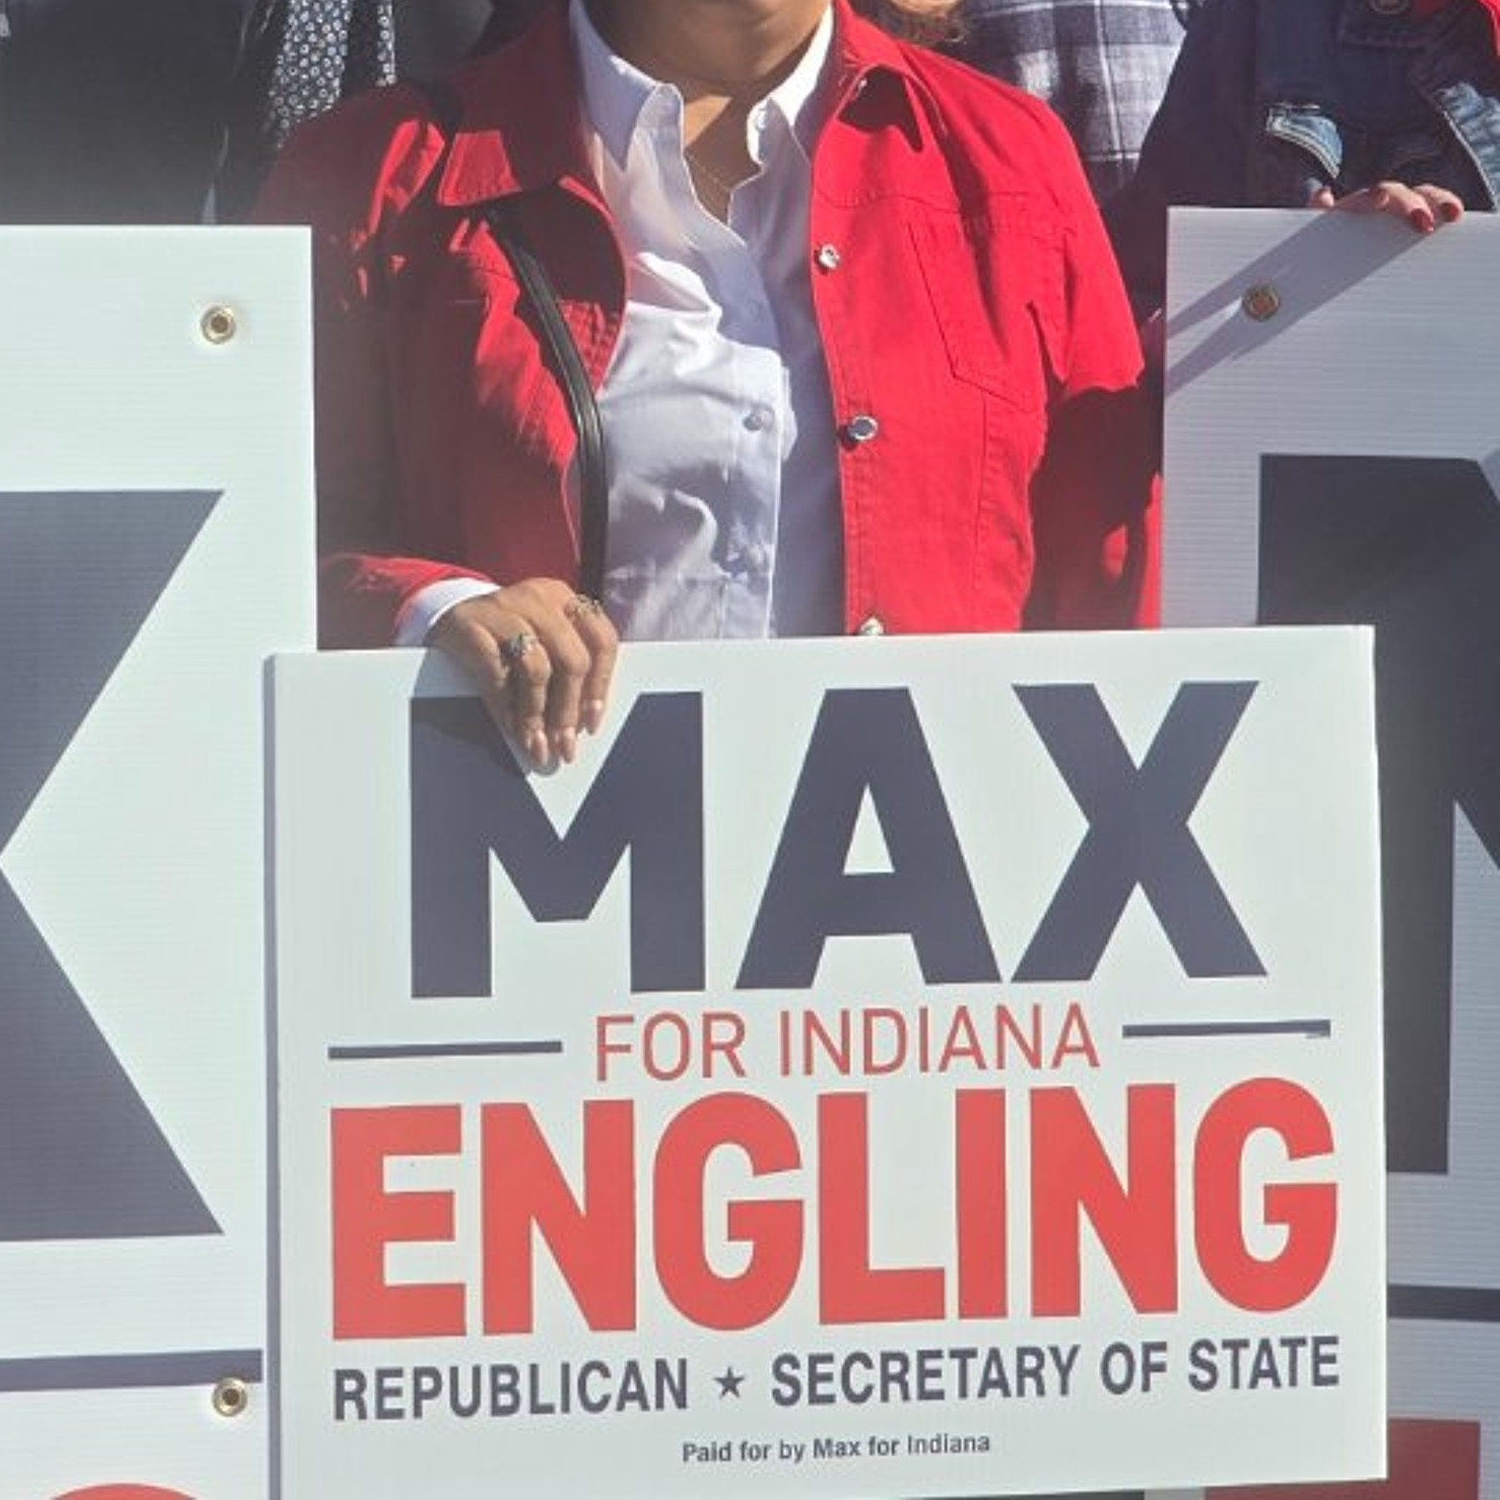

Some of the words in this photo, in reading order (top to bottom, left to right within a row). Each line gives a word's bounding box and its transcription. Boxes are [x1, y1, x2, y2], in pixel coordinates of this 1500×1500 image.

[409, 680, 1269, 999] MAX
[595, 1008, 747, 1082] FOR
[778, 1003, 1101, 1077] INDIANA
[330, 1077, 1339, 1341] ENGLING
[333, 1357, 689, 1421] REPUBLICAN
[770, 1345, 1081, 1408] SECRETARY
[1100, 1341, 1169, 1395] OF
[1187, 1335, 1340, 1392] STATE
[682, 1441, 732, 1463] Paid
[739, 1440, 770, 1462] for
[778, 1439, 806, 1464] by
[812, 1437, 861, 1459] Max
[867, 1435, 900, 1456] for
[906, 1432, 991, 1455] Indiana
